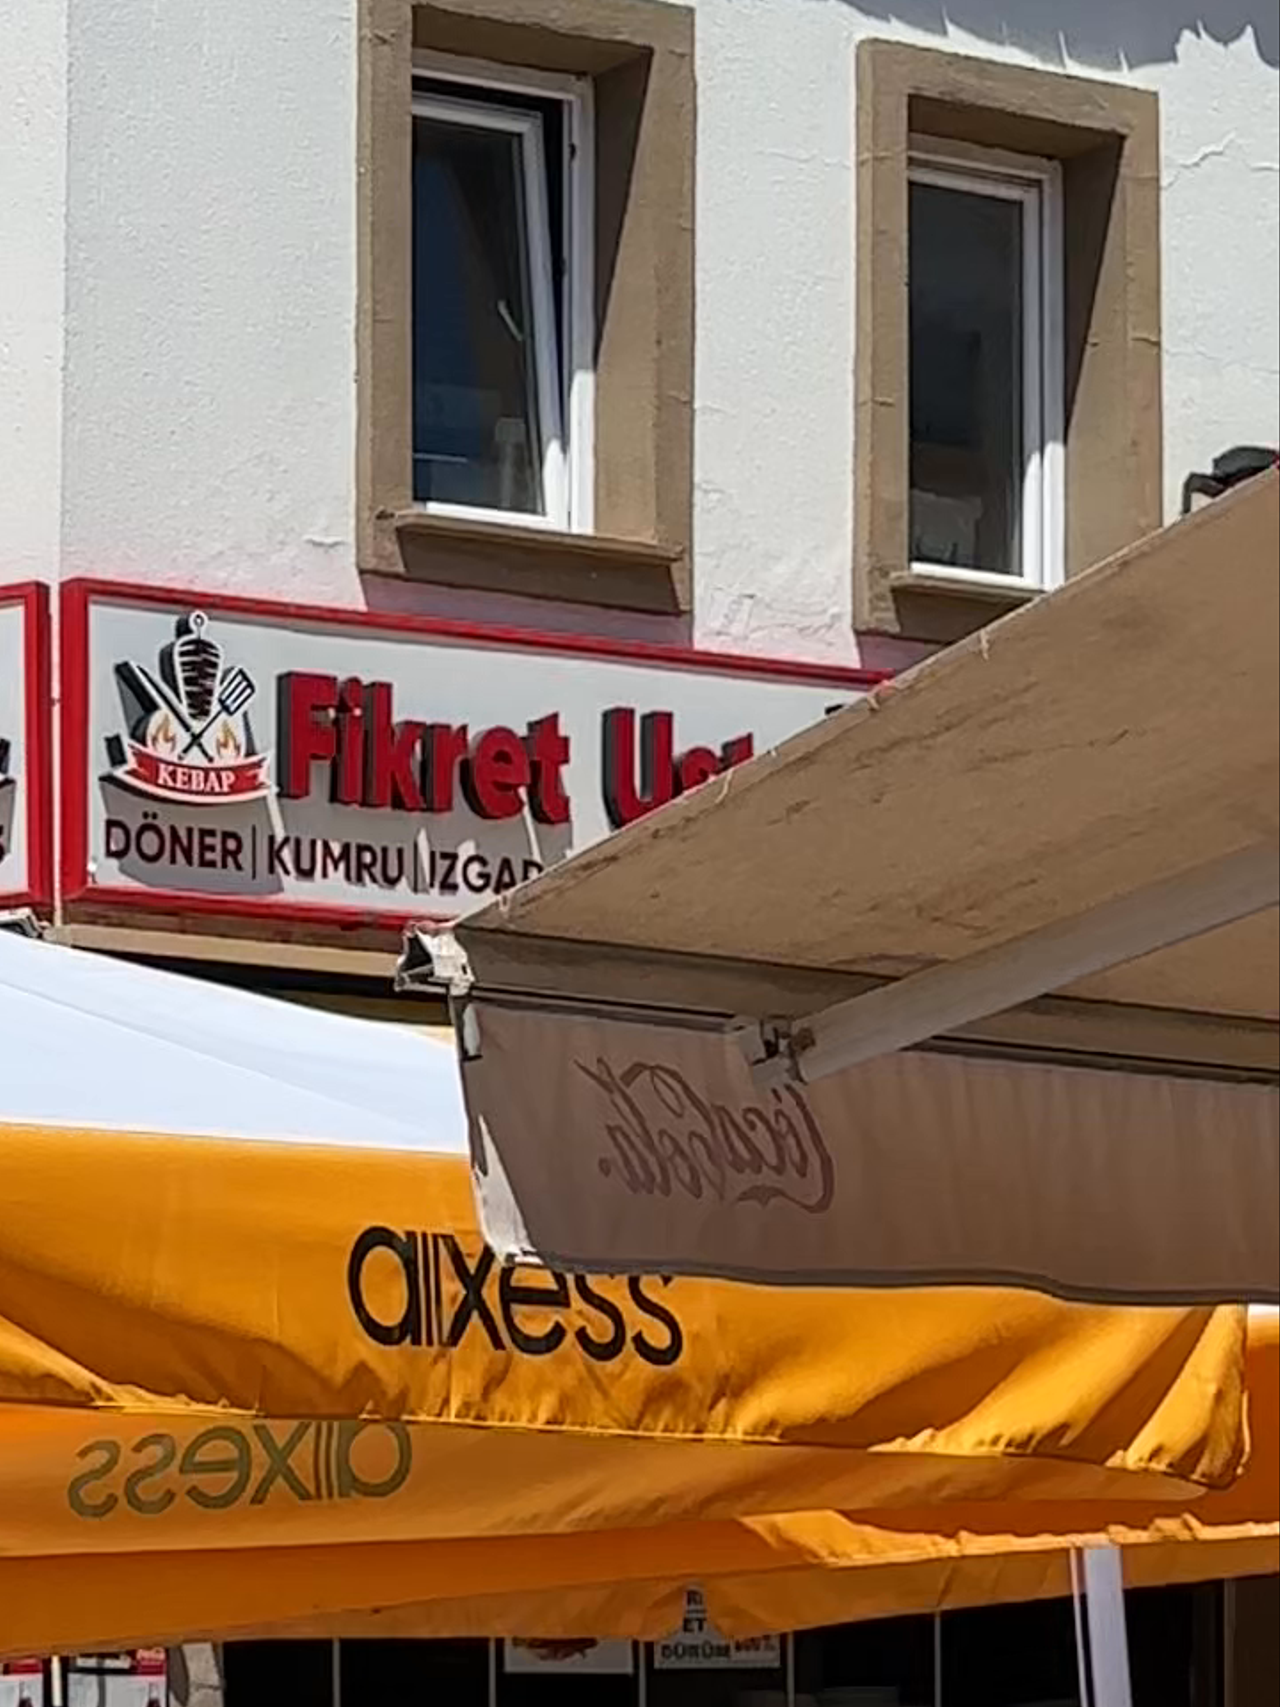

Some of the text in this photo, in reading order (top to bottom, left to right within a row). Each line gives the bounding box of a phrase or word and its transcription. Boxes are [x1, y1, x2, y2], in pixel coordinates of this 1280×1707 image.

[155, 764, 236, 795] KEBAP
[278, 671, 571, 825] Fikret
[105, 811, 243, 871] DÖNER
[267, 835, 404, 889] KUMRU
[346, 1224, 684, 1365] axess
